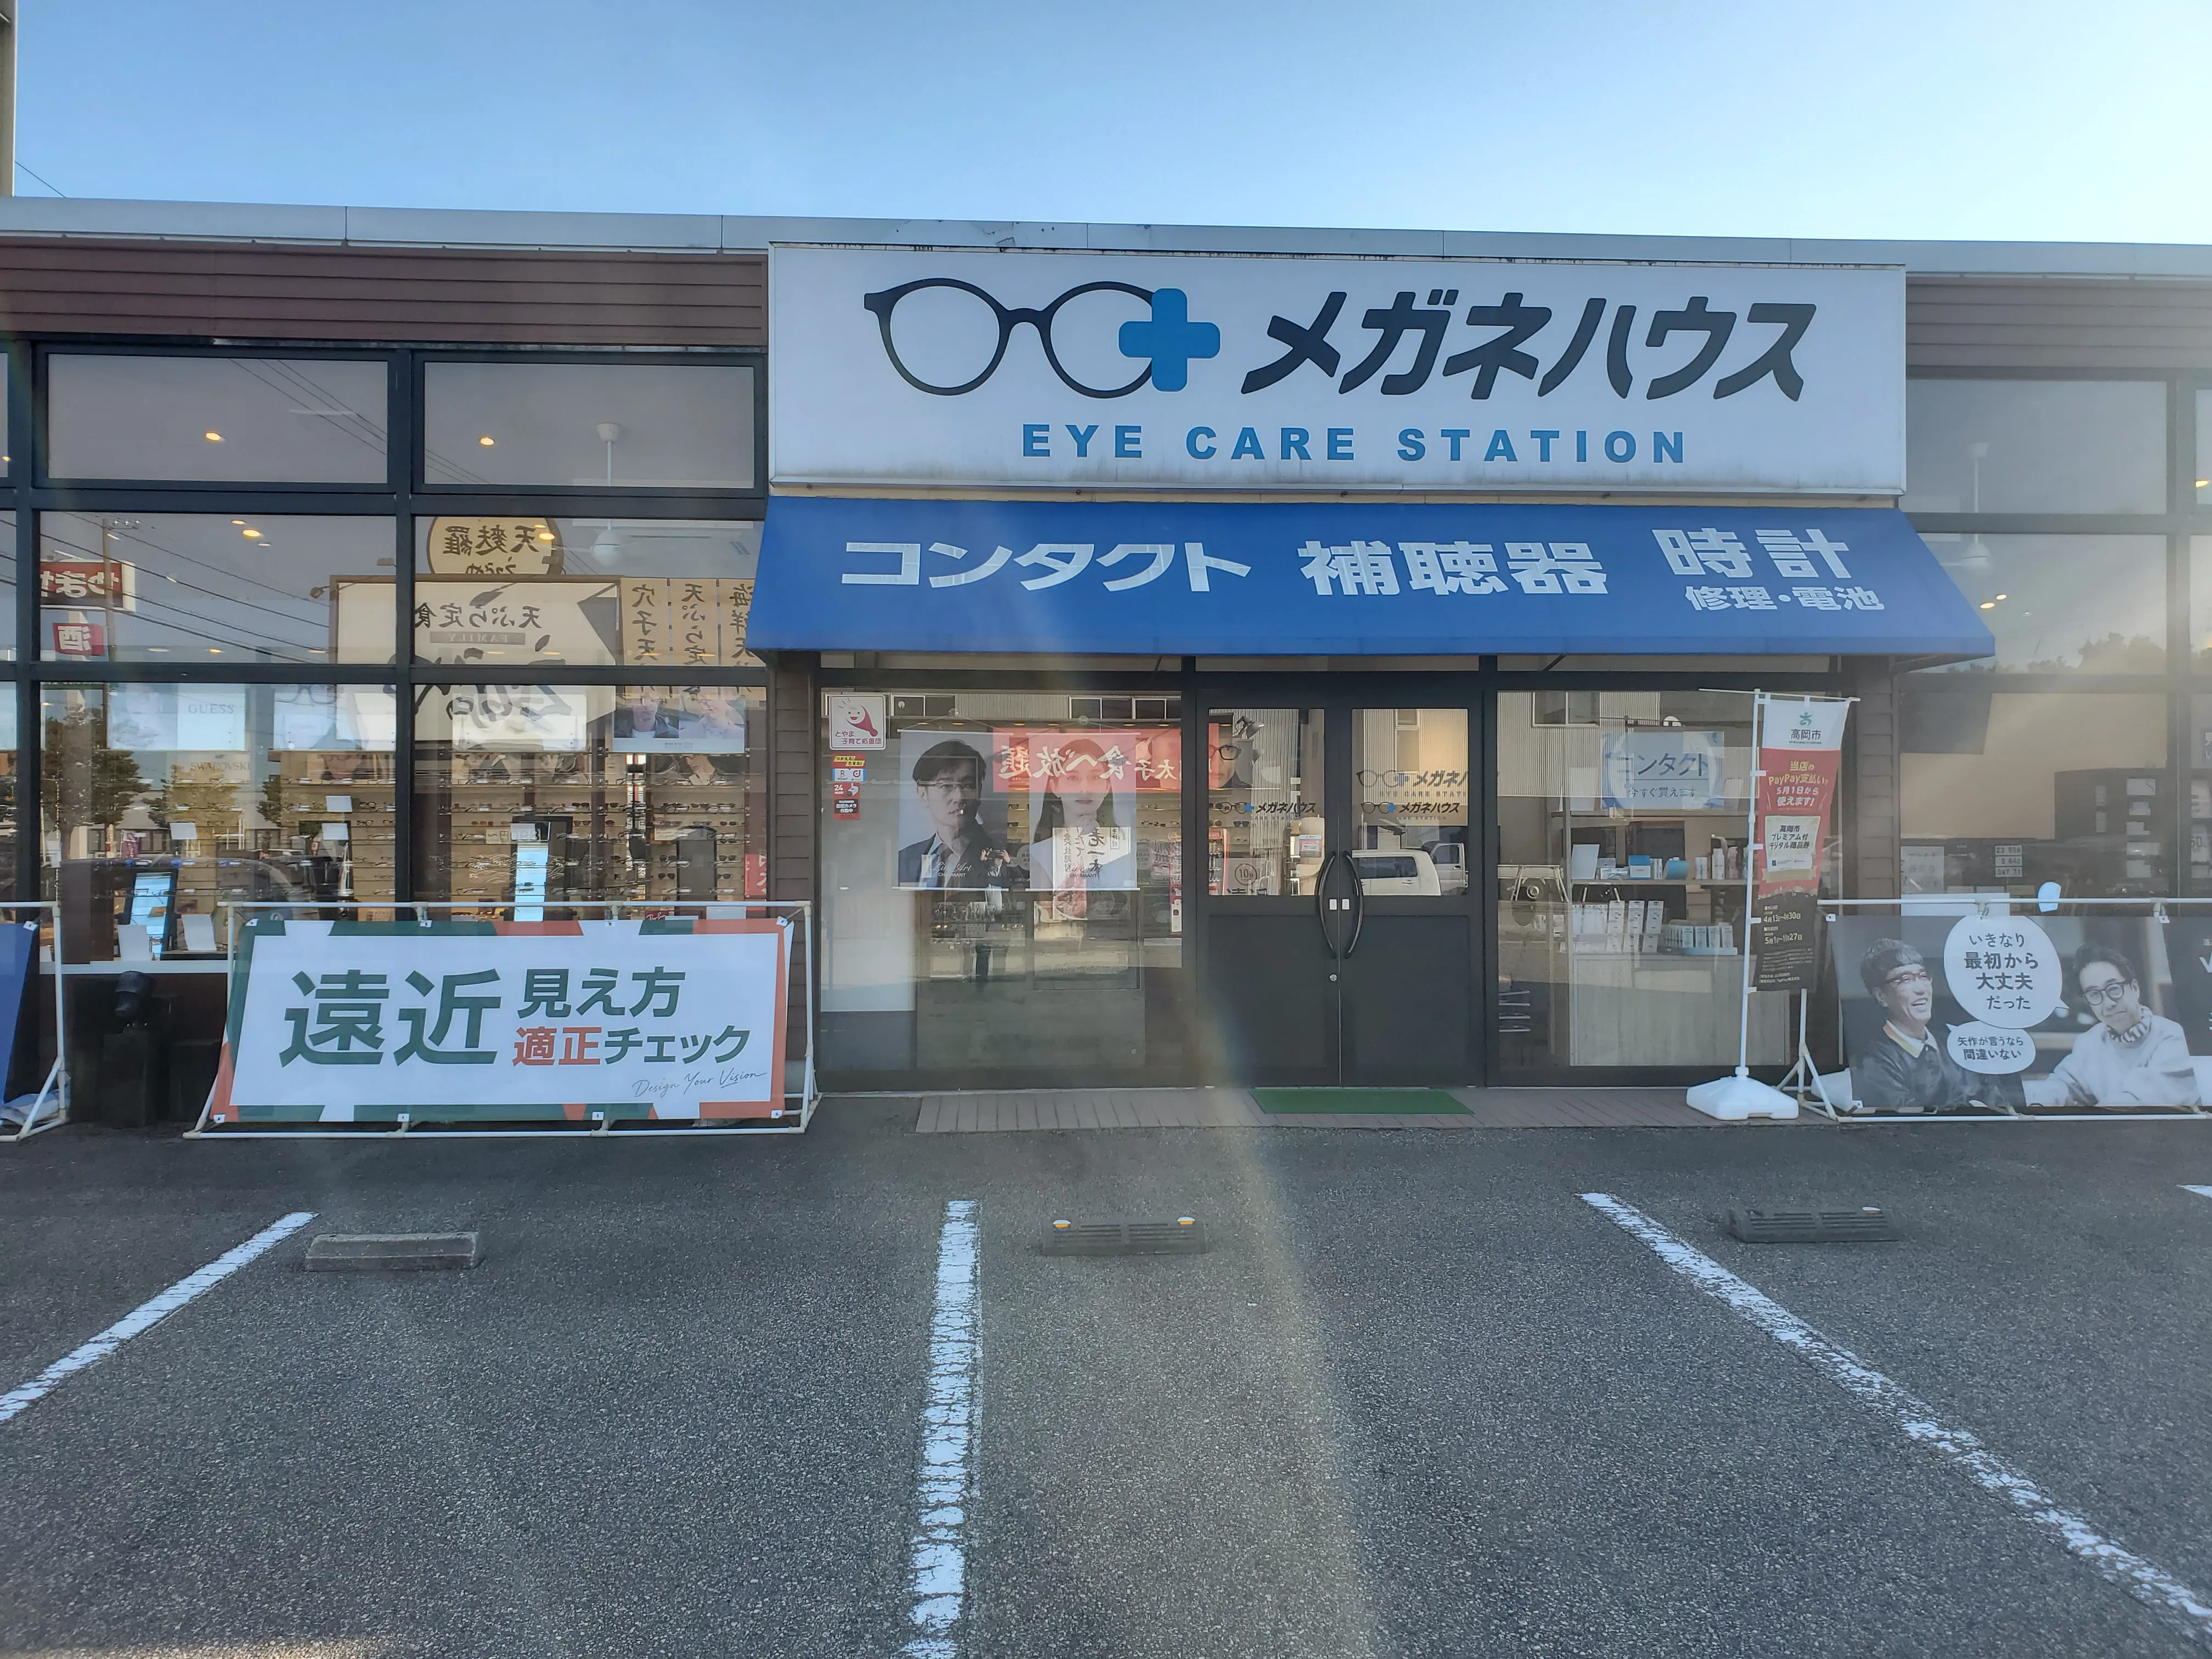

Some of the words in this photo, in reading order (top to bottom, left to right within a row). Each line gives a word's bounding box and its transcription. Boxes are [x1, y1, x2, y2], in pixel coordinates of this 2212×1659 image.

[1240, 289, 1817, 402] メガネハウス
[1023, 424, 1142, 459] EYE
[1186, 426, 1355, 460] CARE
[1397, 428, 1685, 463] STATION
[842, 541, 1251, 592] コンタクト
[1297, 540, 1608, 596] 補聴器
[1651, 527, 1852, 579] 時計
[1684, 585, 1884, 612] 修理・電池
[188, 703, 234, 714] GUESS
[1791, 729, 1821, 740] 高岡市
[1256, 802, 1316, 814] メガネハウス
[1398, 802, 1460, 814] メガネハウス
[1969, 933, 2025, 947] いきなり
[1963, 952, 2039, 970] 最初から
[1976, 972, 2033, 991] 大丈夫
[517, 966, 686, 1019] 見え方
[1986, 995, 2032, 1010] だった
[279, 969, 502, 1068] 遠近
[512, 1024, 751, 1066] 適正チェック
[1957, 1035, 2024, 1047] 矢作が言うなら
[1963, 1047, 2022, 1060] 間違いない
[632, 1078, 680, 1098] Design
[684, 1072, 714, 1094] Your
[719, 1067, 768, 1088] Vision
